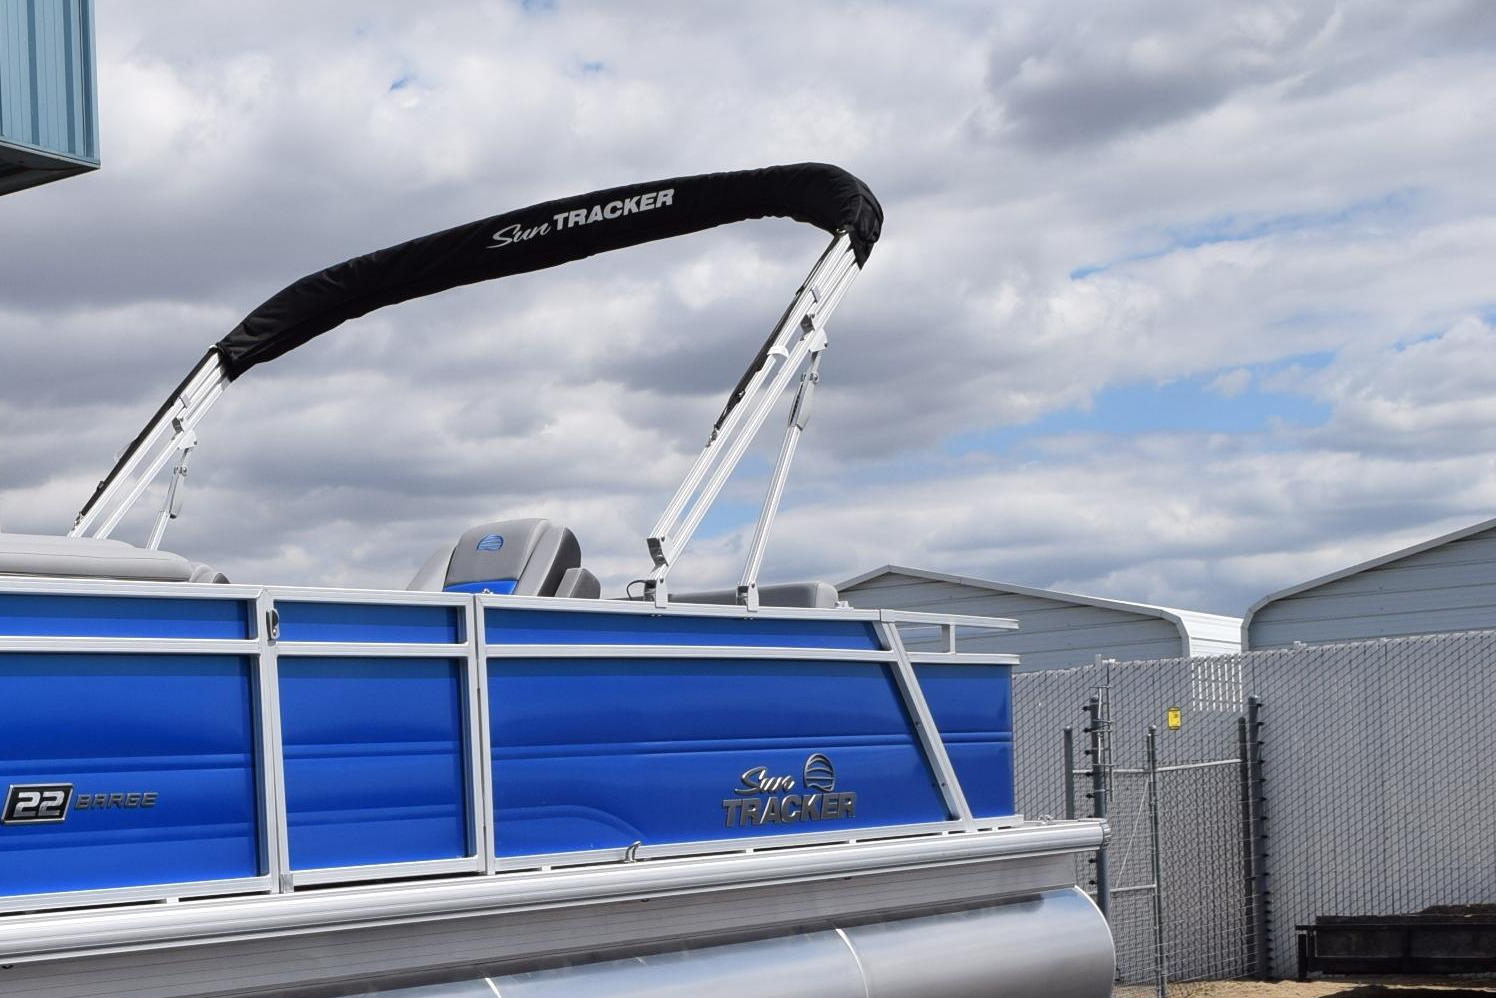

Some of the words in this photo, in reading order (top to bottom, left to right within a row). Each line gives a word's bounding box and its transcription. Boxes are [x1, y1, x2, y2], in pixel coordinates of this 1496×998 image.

[486, 223, 552, 249] Sun
[554, 188, 675, 231] TRACKER
[734, 766, 796, 794] Sun
[13, 790, 65, 818] 22
[75, 791, 159, 811] BARGE
[722, 791, 856, 828] TRACKER
